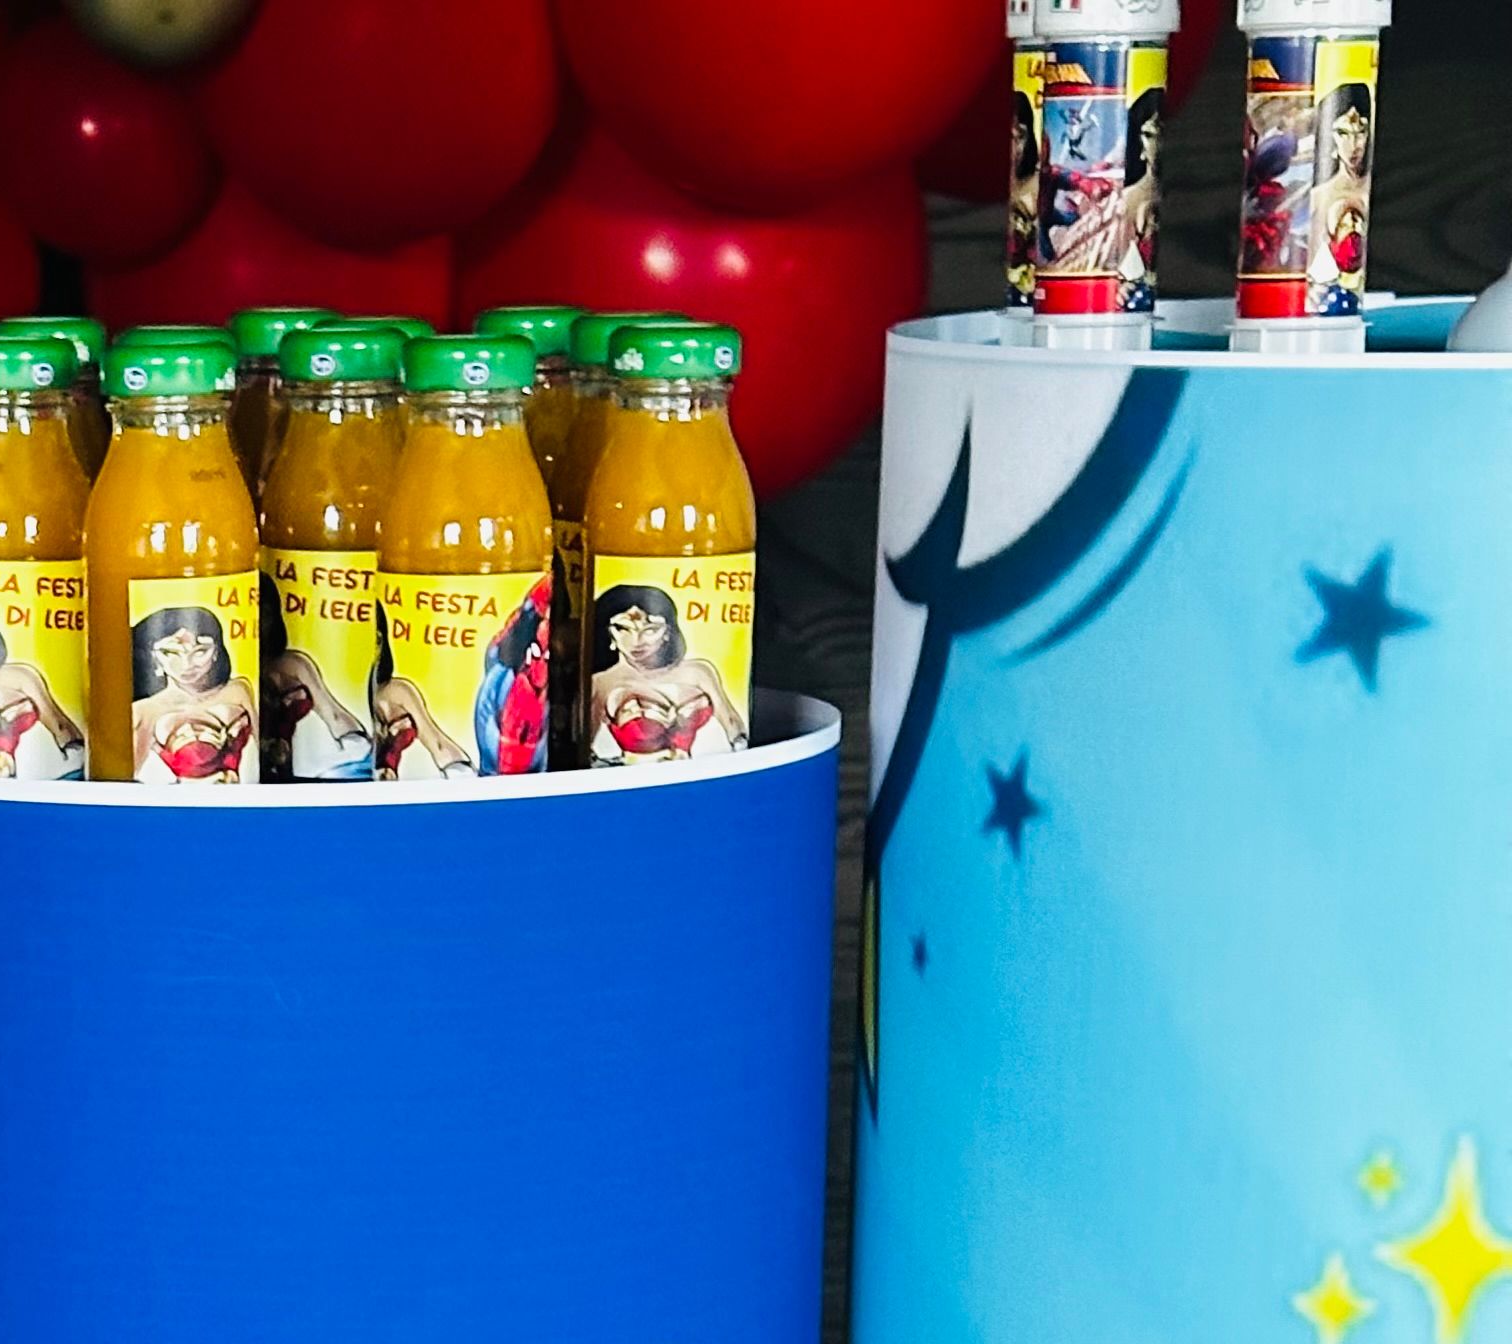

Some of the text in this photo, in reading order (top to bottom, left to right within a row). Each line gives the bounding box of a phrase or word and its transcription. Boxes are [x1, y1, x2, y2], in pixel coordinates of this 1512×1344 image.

[36, 576, 84, 598] FEST
[276, 559, 375, 590] LA FEST
[672, 568, 752, 592] LA FEST
[217, 586, 239, 607] LA
[286, 592, 306, 616] DI
[320, 598, 373, 622] LELE
[384, 583, 498, 617] LA FESTA
[7, 604, 84, 631] DI LELE
[686, 601, 751, 624] DI LELE
[230, 619, 247, 640] DI
[393, 618, 477, 648] DI LELE
